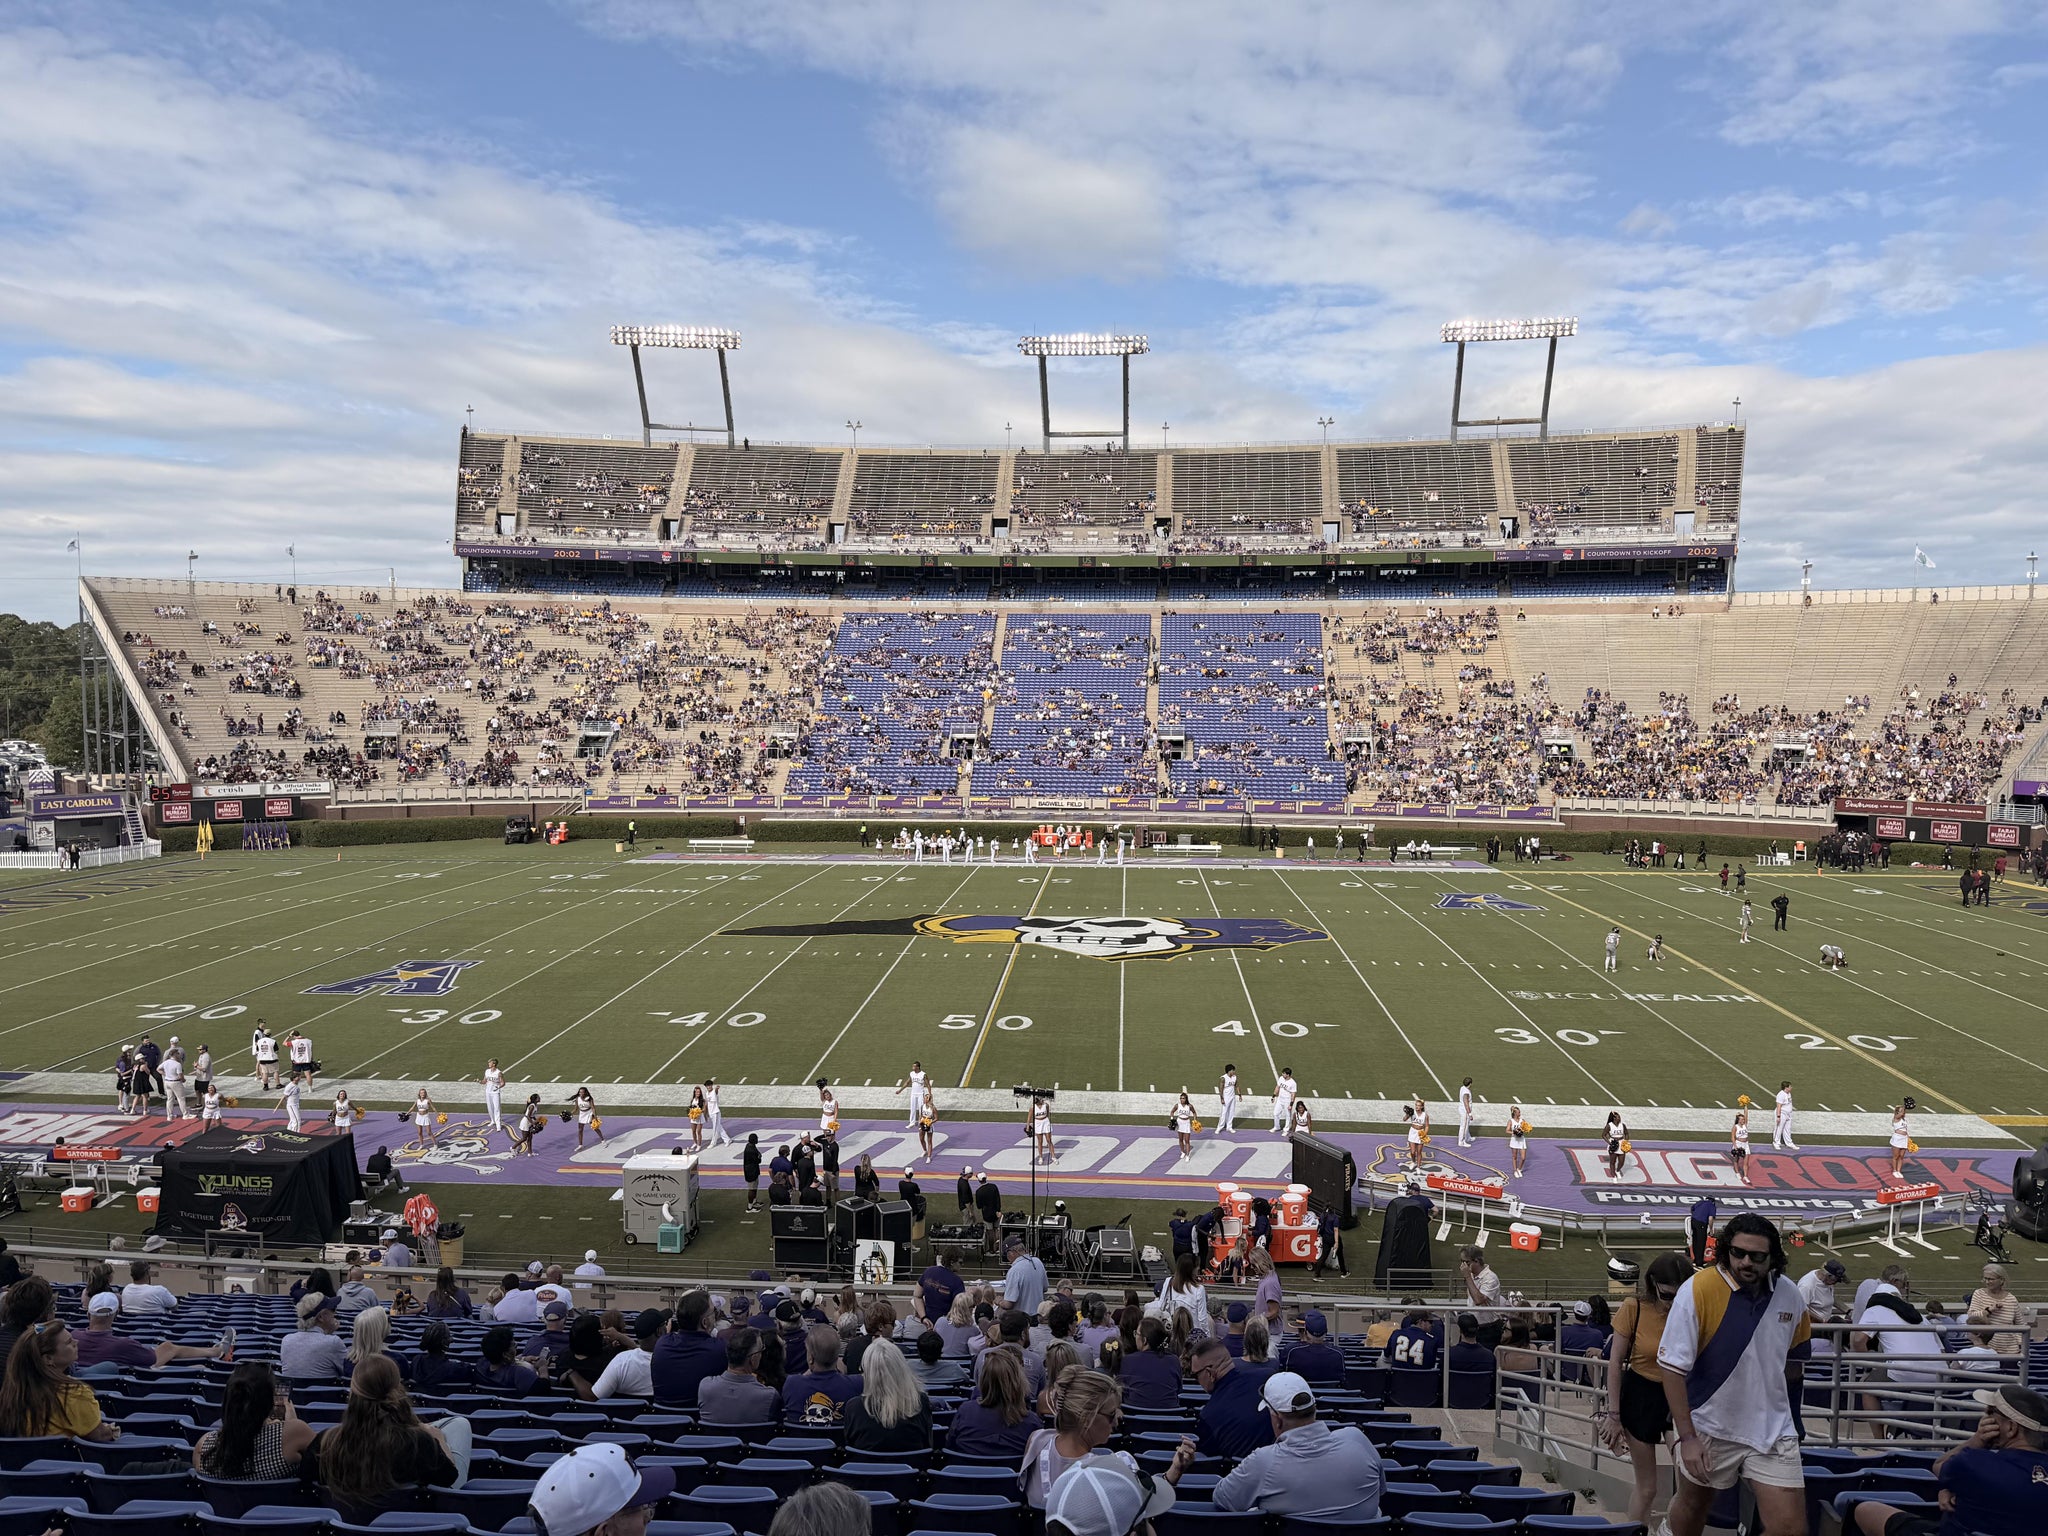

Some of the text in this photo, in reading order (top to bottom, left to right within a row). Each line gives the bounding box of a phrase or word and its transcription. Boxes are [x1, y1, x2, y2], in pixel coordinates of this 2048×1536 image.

[553, 550, 581, 558] 20:02
[1687, 547, 1718, 556] 20:02
[152, 788, 170, 800] 25
[218, 786, 244, 794] crush
[40, 798, 113, 809] EAST CAROLINA
[1044, 836, 1053, 845] G
[1069, 835, 1077, 845] G
[1340, 881, 1398, 889] 30
[1507, 884, 1565, 892] 20
[1544, 992, 1763, 1003] ECU HEALTH
[138, 1004, 248, 1021] 20
[401, 1009, 503, 1025] 30
[667, 1011, 767, 1028] 40
[937, 1014, 1034, 1031] 50
[1211, 1019, 1309, 1038] 40
[1495, 1026, 1601, 1047] 30
[1783, 1032, 1898, 1052] 20
[0, 1112, 150, 1145] BIG
[449, 1128, 494, 1137] ECU
[67, 1150, 103, 1159] GATORADE
[1573, 1149, 2013, 1194] BIG ROCK
[1443, 1181, 1485, 1193] GATORADE
[1895, 1189, 1927, 1200] GATORADE
[68, 1199, 77, 1208] G
[143, 1199, 152, 1208] G
[1237, 1203, 1247, 1213] G
[1290, 1205, 1299, 1214] G
[180, 1210, 215, 1221] TOGETHER
[1290, 1234, 1311, 1257] G
[1519, 1236, 1528, 1246] G
[1778, 1311, 1793, 1320] ECU
[1394, 1335, 1426, 1366] 24
